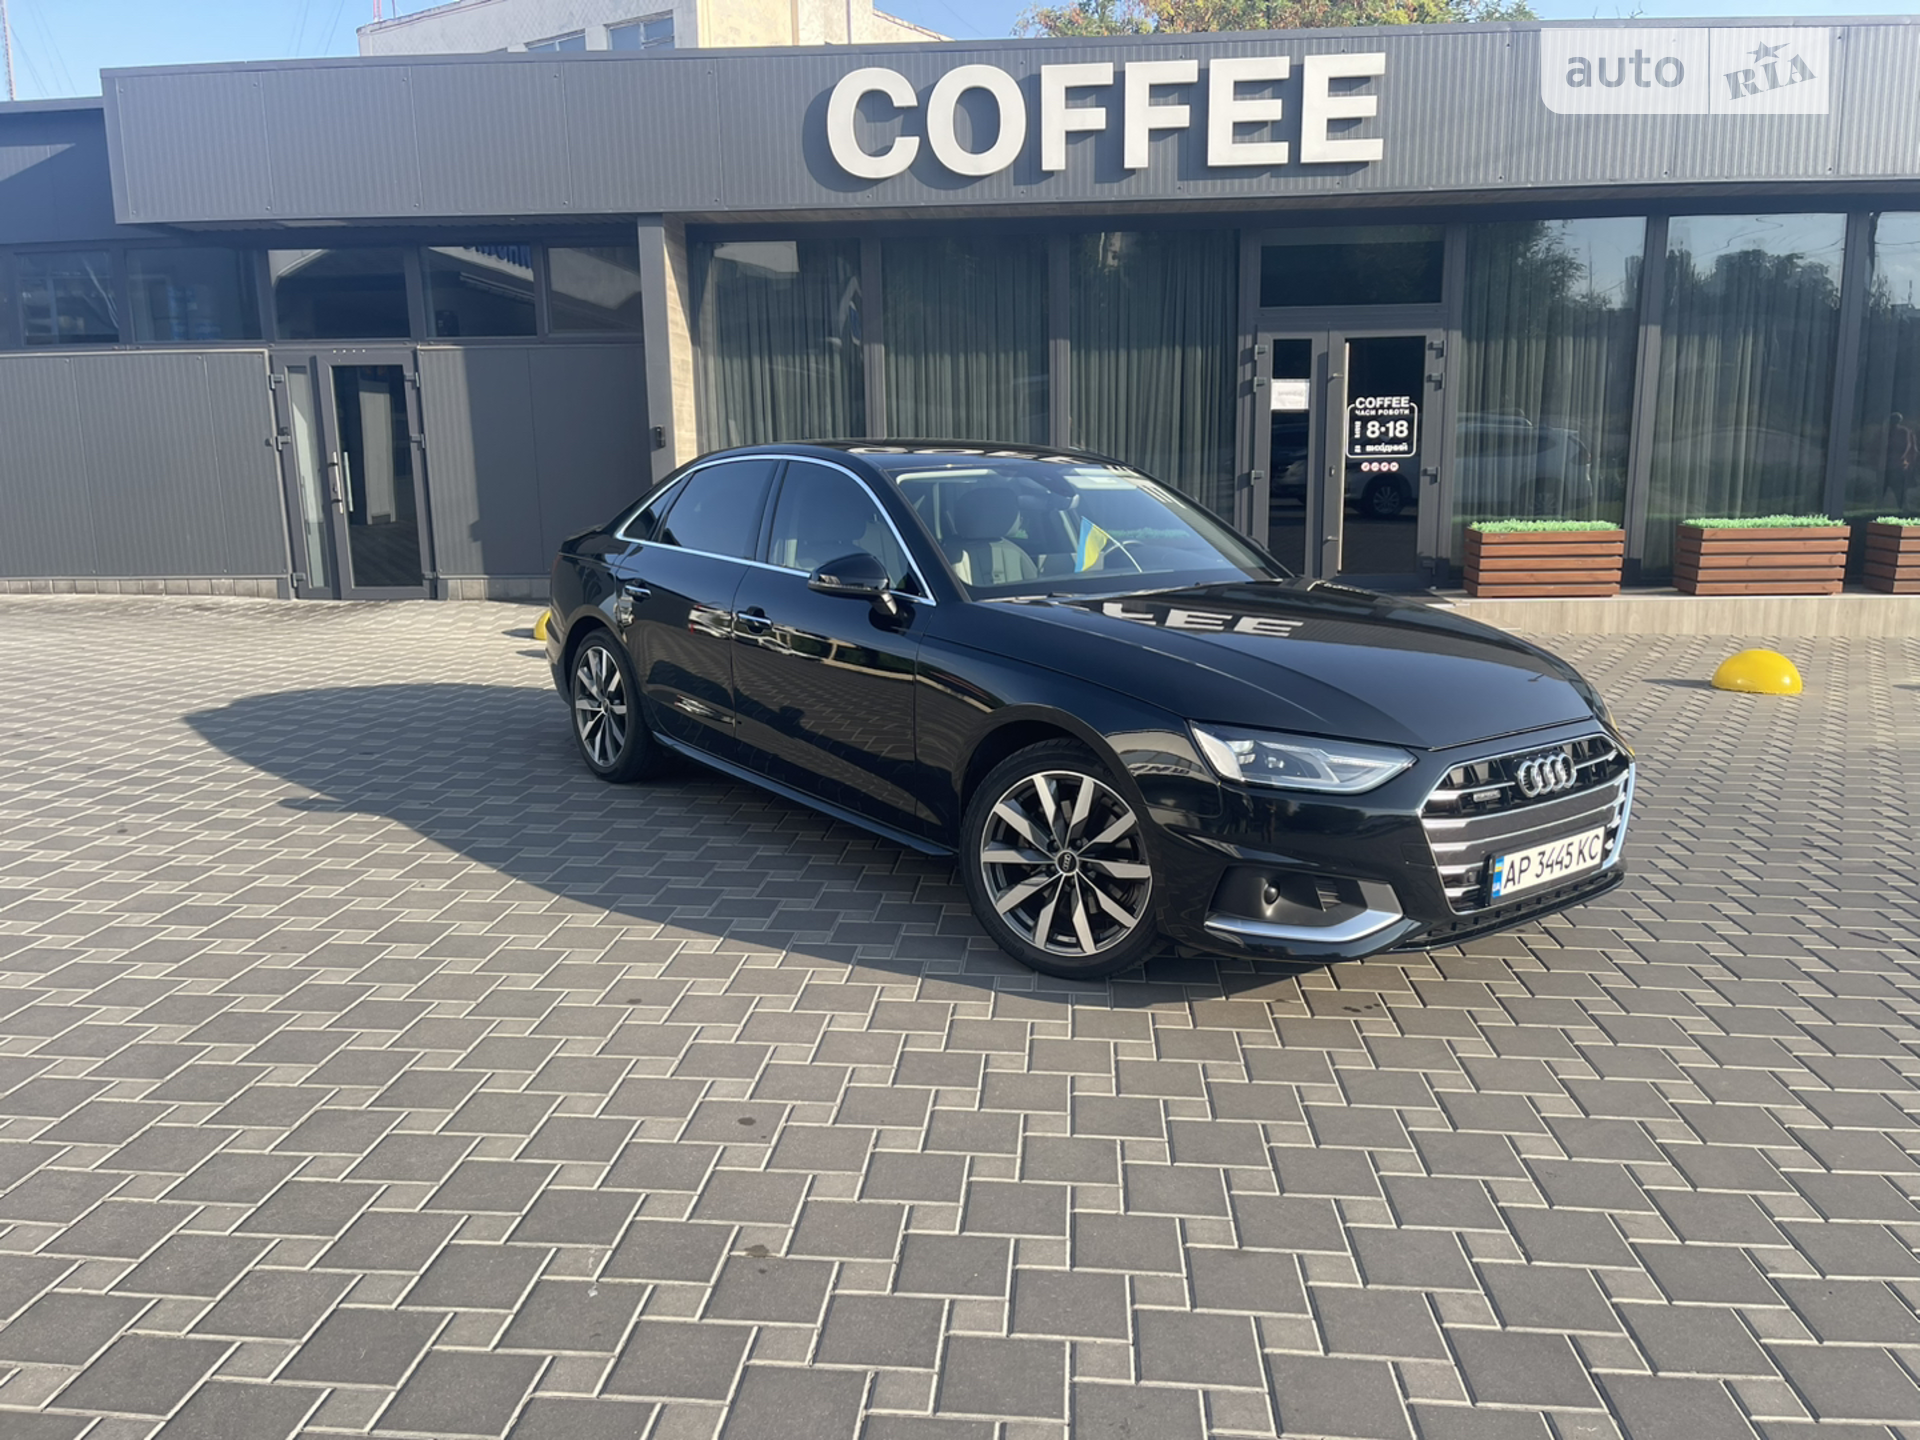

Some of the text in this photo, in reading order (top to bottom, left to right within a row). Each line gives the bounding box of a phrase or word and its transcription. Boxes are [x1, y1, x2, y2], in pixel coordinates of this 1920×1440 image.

[827, 52, 1386, 179] COFFEE
[1355, 396, 1410, 409] COFFEE
[1503, 834, 1600, 889] AP 3445 KC
